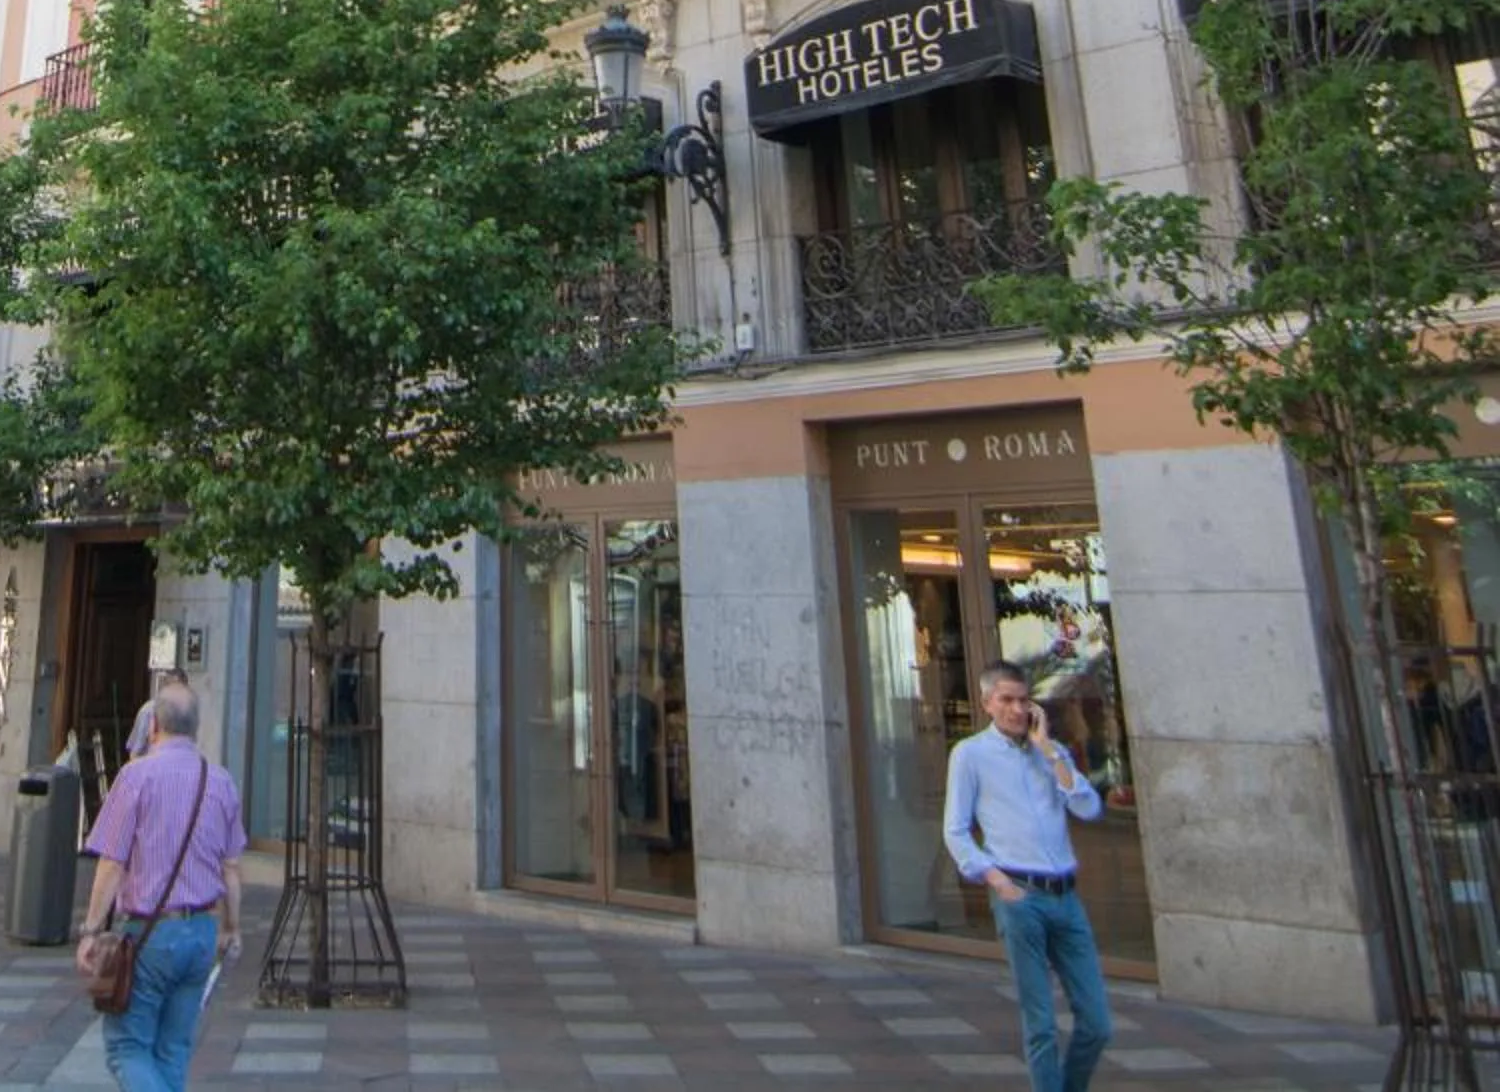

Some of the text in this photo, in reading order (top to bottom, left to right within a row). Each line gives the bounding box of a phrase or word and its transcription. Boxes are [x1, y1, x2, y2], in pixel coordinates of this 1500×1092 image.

[757, 29, 855, 87] HIGH
[797, 43, 944, 105] HOTELES
[856, 428, 1077, 469] PUNT ROMA
